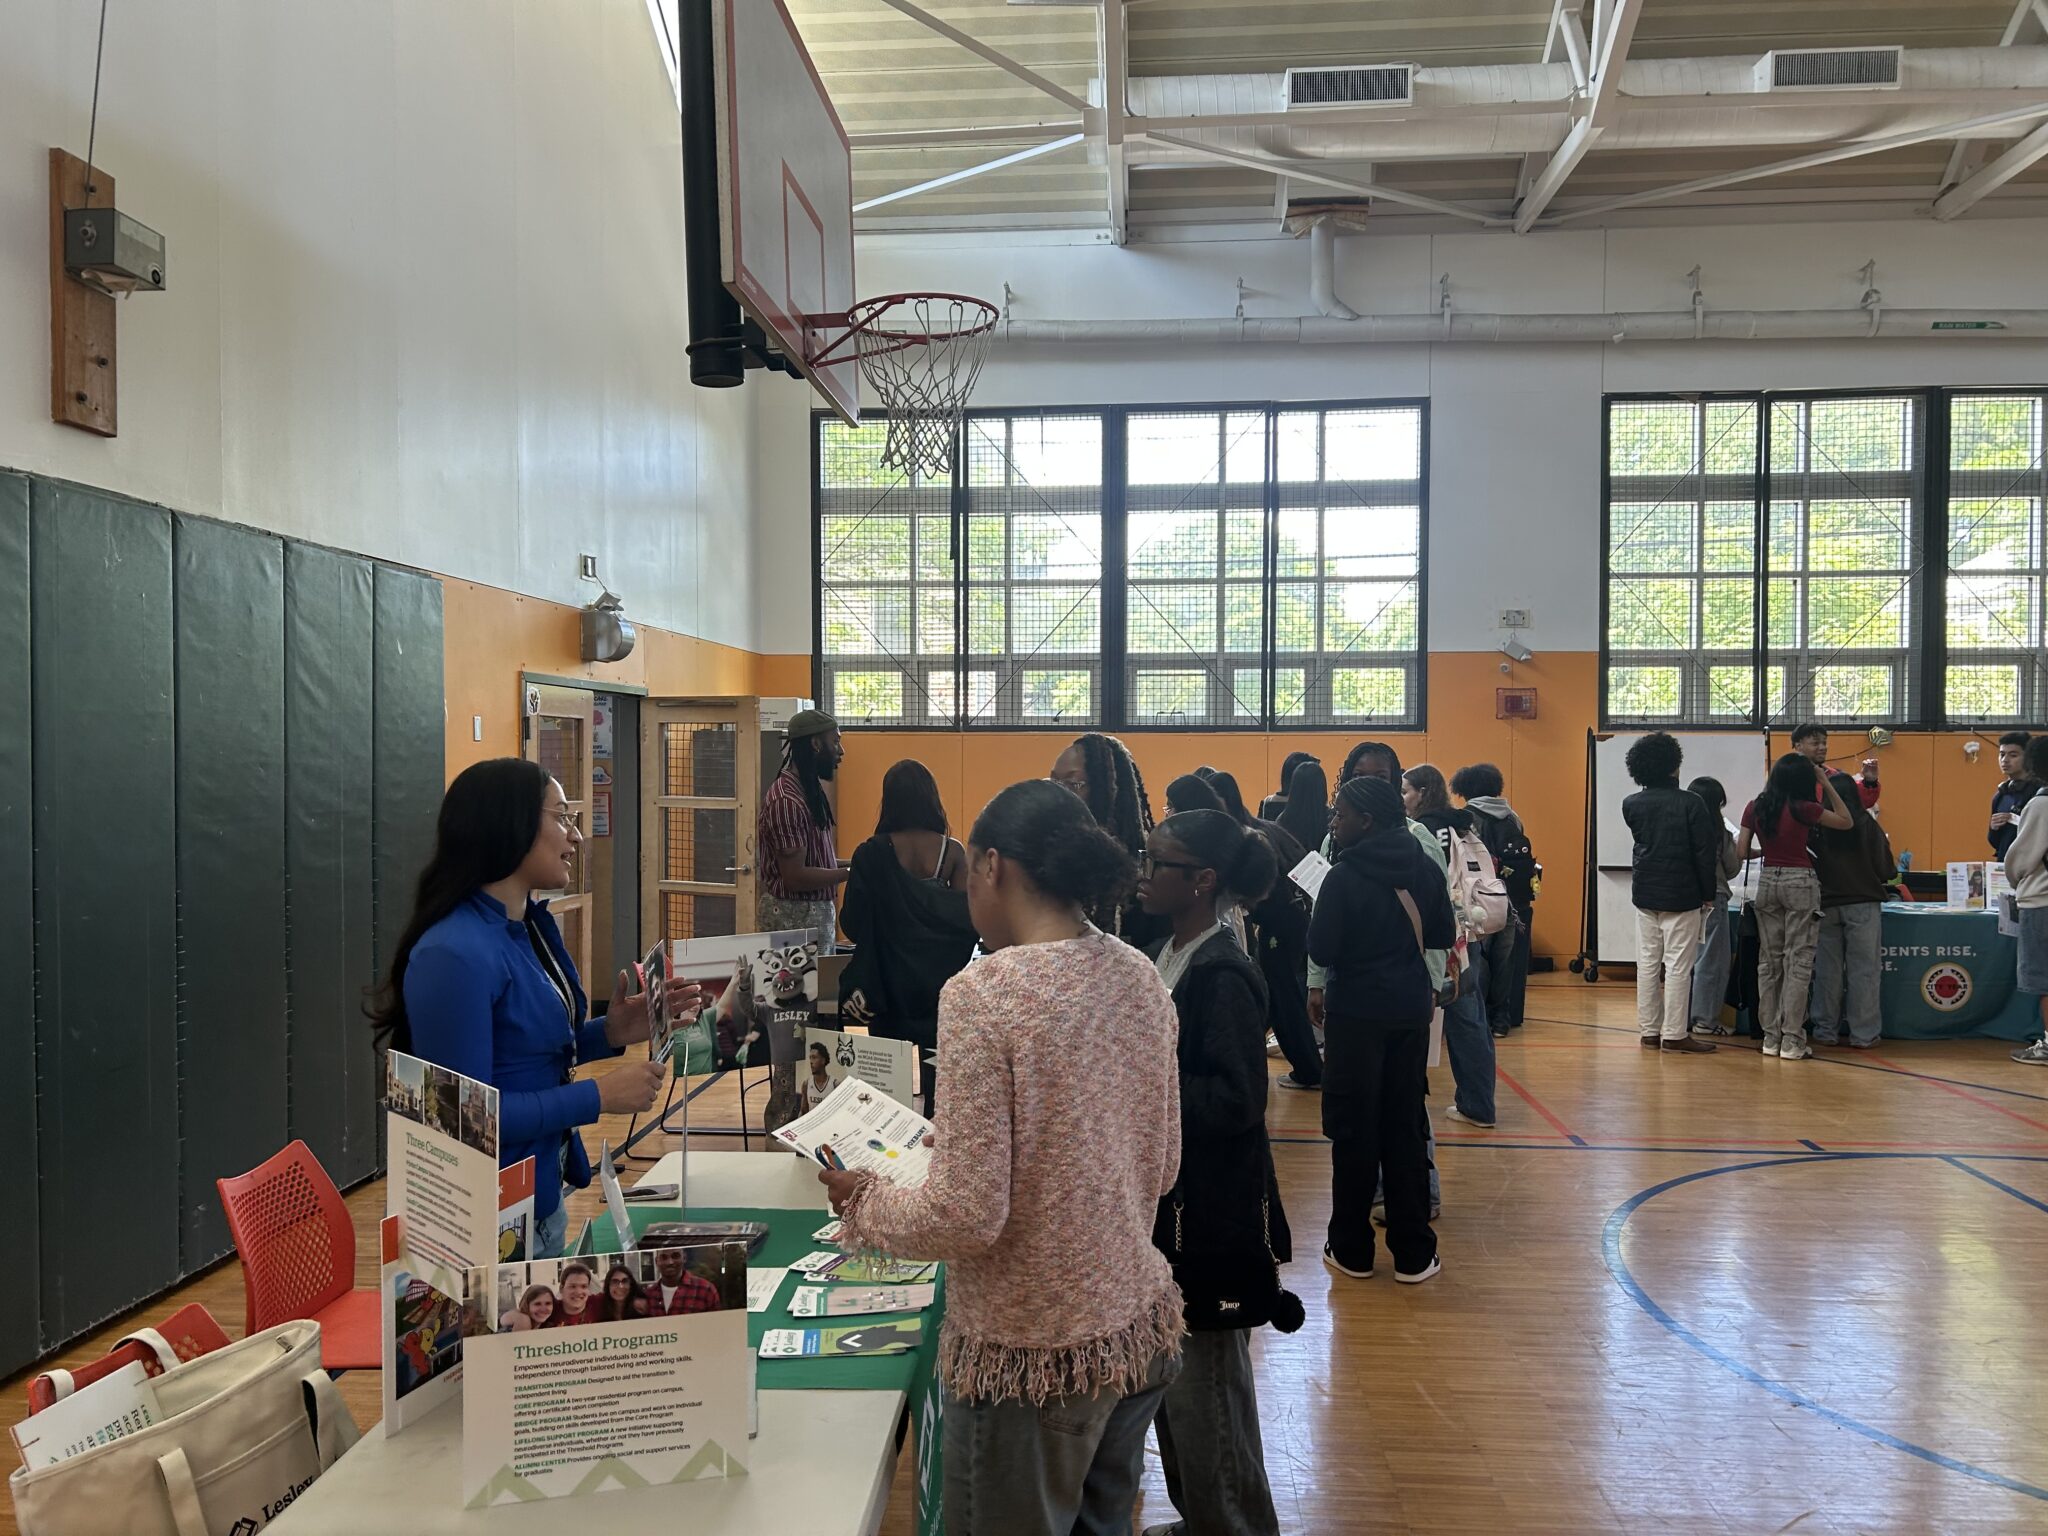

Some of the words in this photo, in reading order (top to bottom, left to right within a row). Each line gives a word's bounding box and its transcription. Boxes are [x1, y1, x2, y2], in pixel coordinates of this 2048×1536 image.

[774, 1010, 810, 1023] LESLEY
[406, 1132, 425, 1151] Three
[514, 1338, 598, 1360] Threshold
[602, 1332, 678, 1350] Programs
[514, 1364, 549, 1372] Empowers
[551, 1359, 593, 1368] neurodiverse
[595, 1354, 629, 1363] individuals
[514, 1371, 561, 1380] independence
[563, 1366, 589, 1374] through
[590, 1363, 615, 1371] tailored
[515, 1383, 553, 1392] TRANSITION
[555, 1379, 586, 1388] PROGRAM
[588, 1376, 614, 1384] Designed
[514, 1390, 550, 1399] independent
[533, 1399, 565, 1407] PROGRAM
[597, 1392, 626, 1400] residential
[540, 1416, 572, 1424] PROGRAM
[580, 1418, 609, 1426] developed
[514, 1444, 552, 1452] neurodiverse
[656, 1428, 684, 1436] previously
[515, 1436, 545, 1445] LIFELONG
[547, 1433, 576, 1441] SUPPORT
[577, 1429, 609, 1437] PROGRAM
[514, 1450, 549, 1460] participated
[567, 1445, 595, 1453] Threshold
[515, 1462, 540, 1470] ALUMNI
[524, 1468, 553, 1477] graduates
[261, 1475, 313, 1522] Lesley
